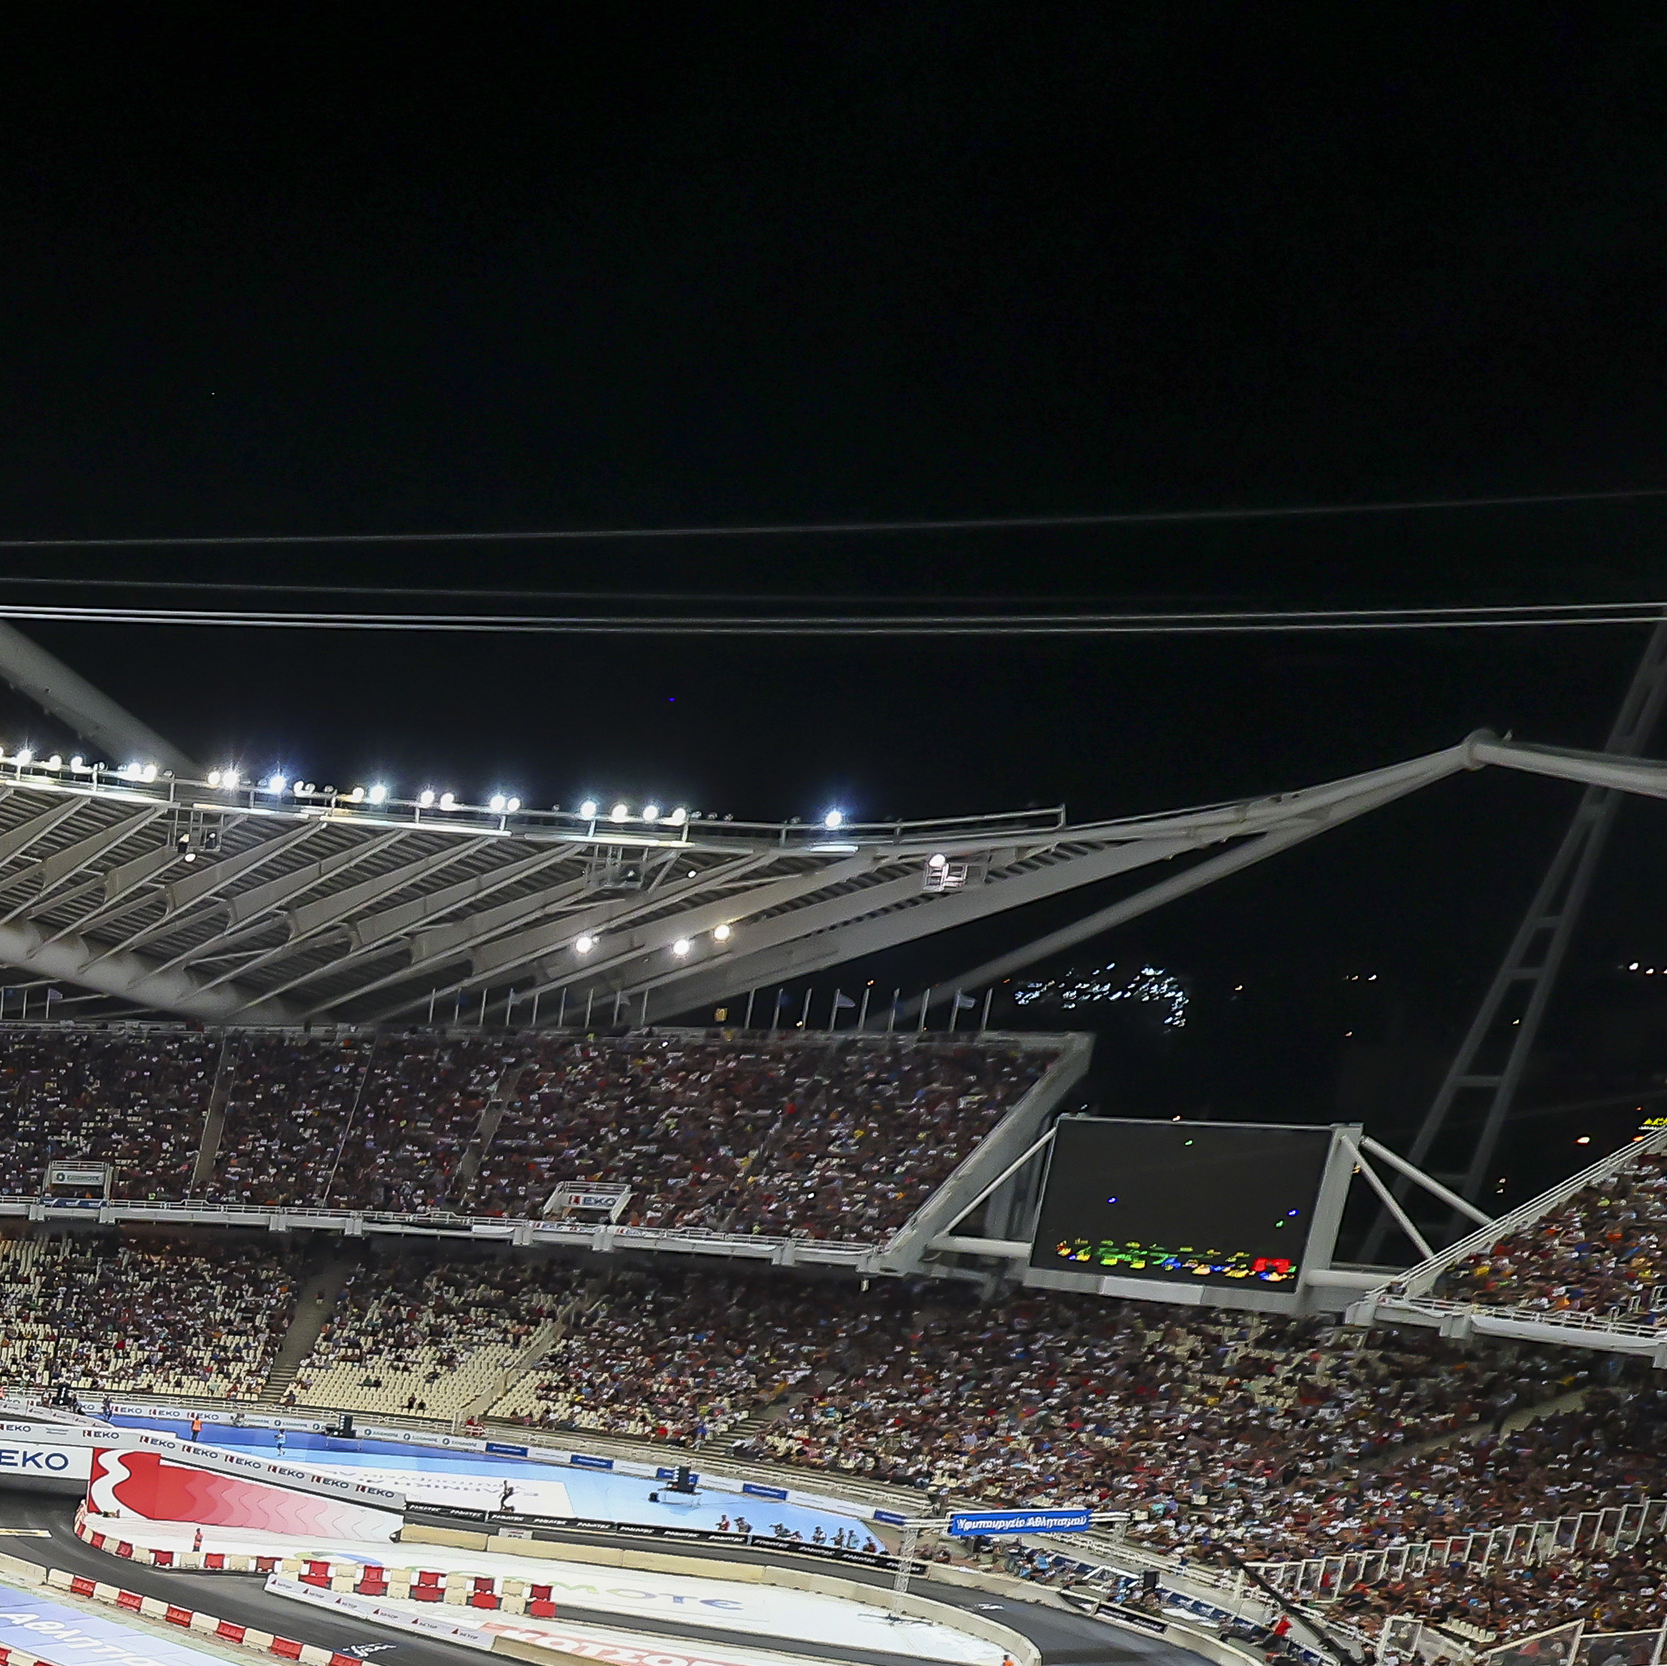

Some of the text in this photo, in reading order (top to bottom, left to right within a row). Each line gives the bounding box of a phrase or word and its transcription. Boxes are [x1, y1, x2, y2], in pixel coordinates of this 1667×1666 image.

[94, 1431, 119, 1439] EKO
[150, 1440, 175, 1449] EKO
[193, 1448, 218, 1458] EKO
[236, 1458, 261, 1468] EKO
[279, 1467, 305, 1478] EKO
[322, 1477, 349, 1488] EKO
[368, 1487, 394, 1498] EKO
